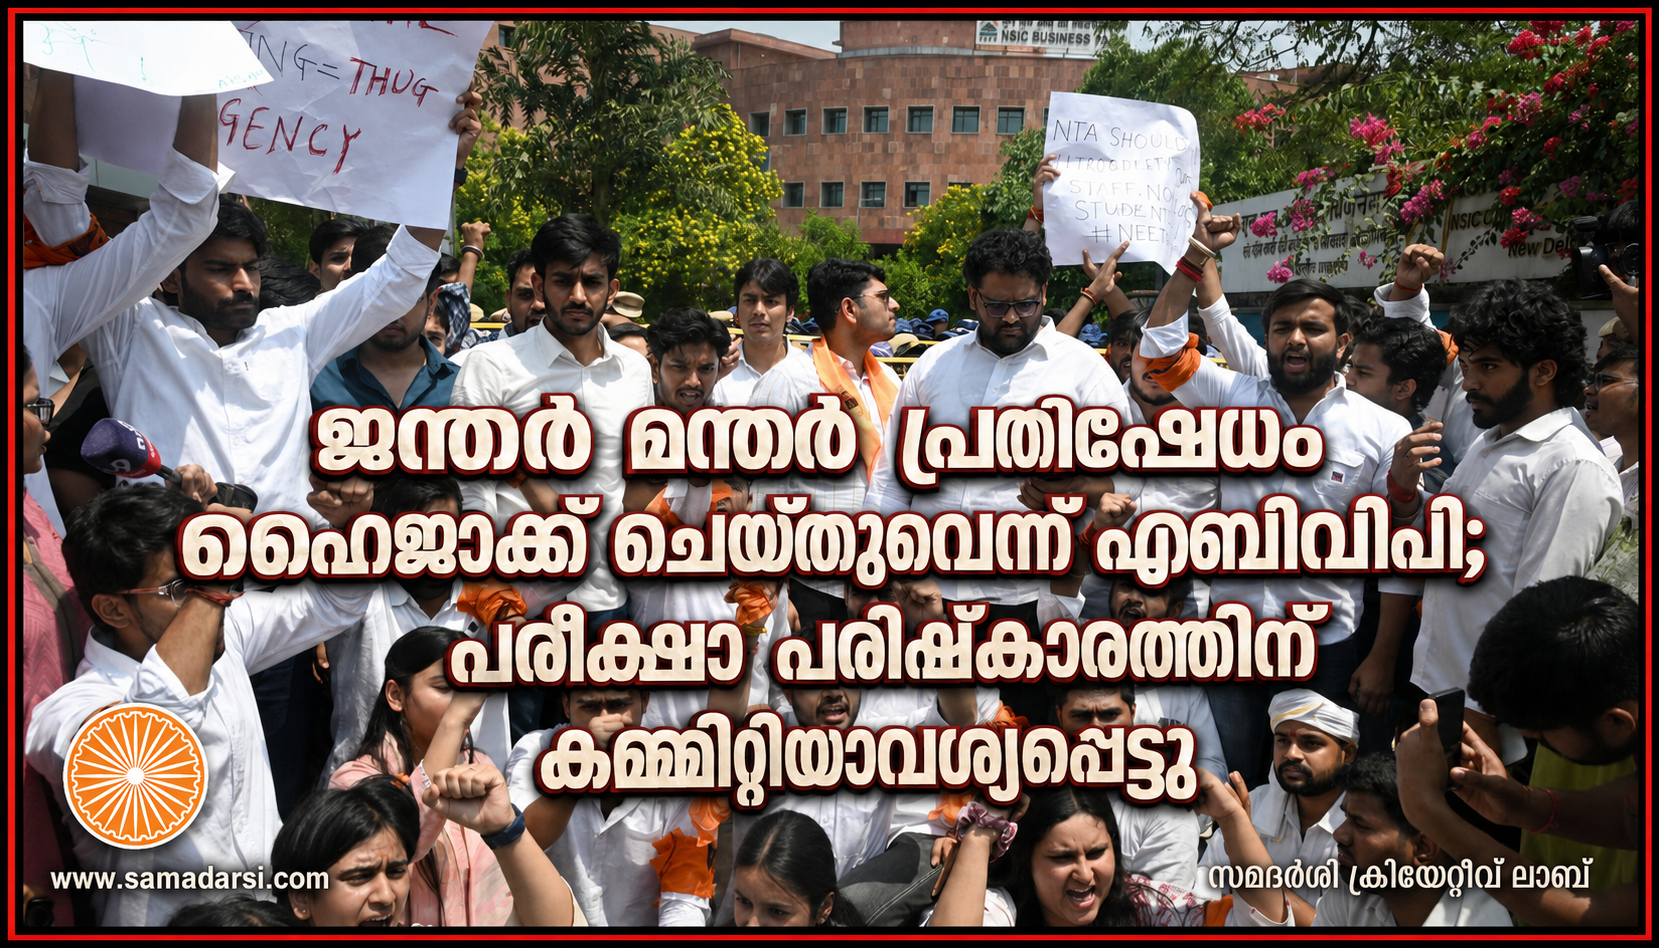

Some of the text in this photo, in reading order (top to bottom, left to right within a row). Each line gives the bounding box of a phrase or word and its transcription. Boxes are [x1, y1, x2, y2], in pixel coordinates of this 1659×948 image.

[1001, 30, 1091, 45] NSIC BUSINESS
[350, 57, 439, 107] THUG
[219, 98, 361, 174] GENCY
[1053, 119, 1188, 152] NTA SHOULD
[1450, 210, 1482, 231] NSIC
[1508, 235, 1571, 258] New Del
